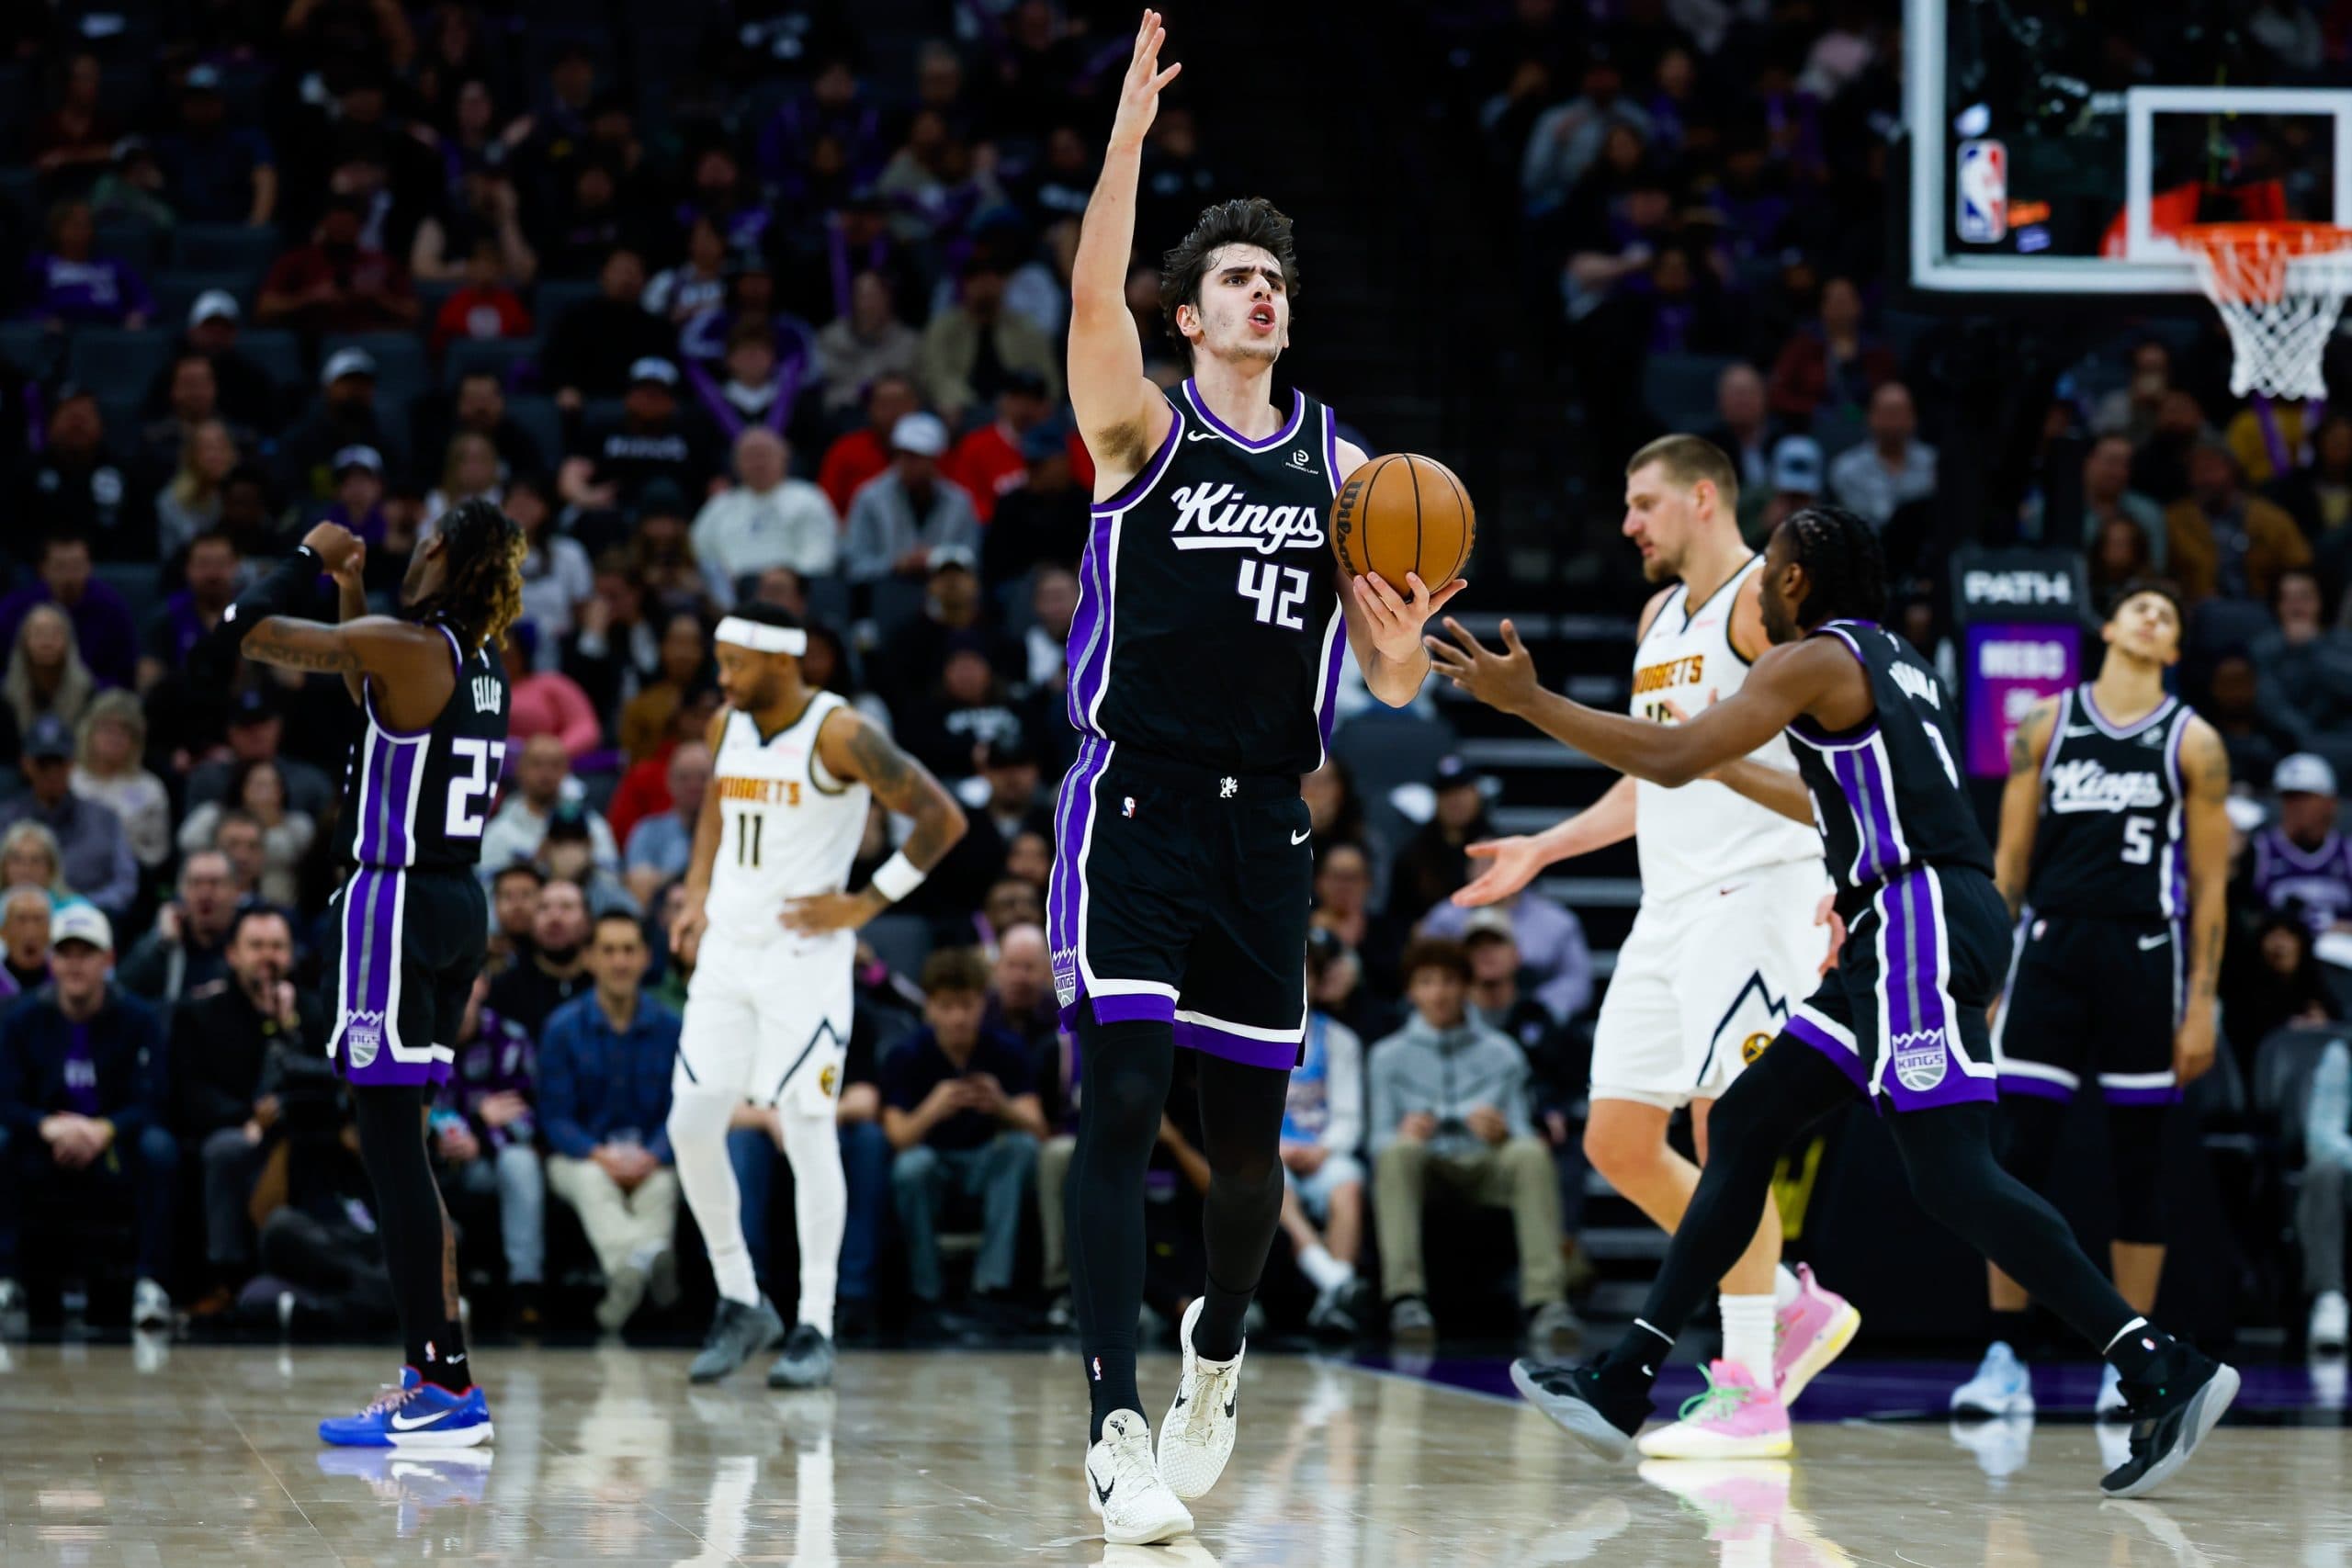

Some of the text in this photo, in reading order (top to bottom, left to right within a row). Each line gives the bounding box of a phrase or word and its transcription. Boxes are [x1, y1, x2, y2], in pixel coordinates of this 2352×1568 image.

[1170, 481, 1325, 555] Kings
[1238, 558, 1310, 631] 42
[471, 675, 503, 715] ELLIS
[2050, 758, 2165, 814] Kings
[738, 812, 763, 867] 11
[2120, 816, 2156, 865] 5
[1898, 1054, 1944, 1069] KINGS
